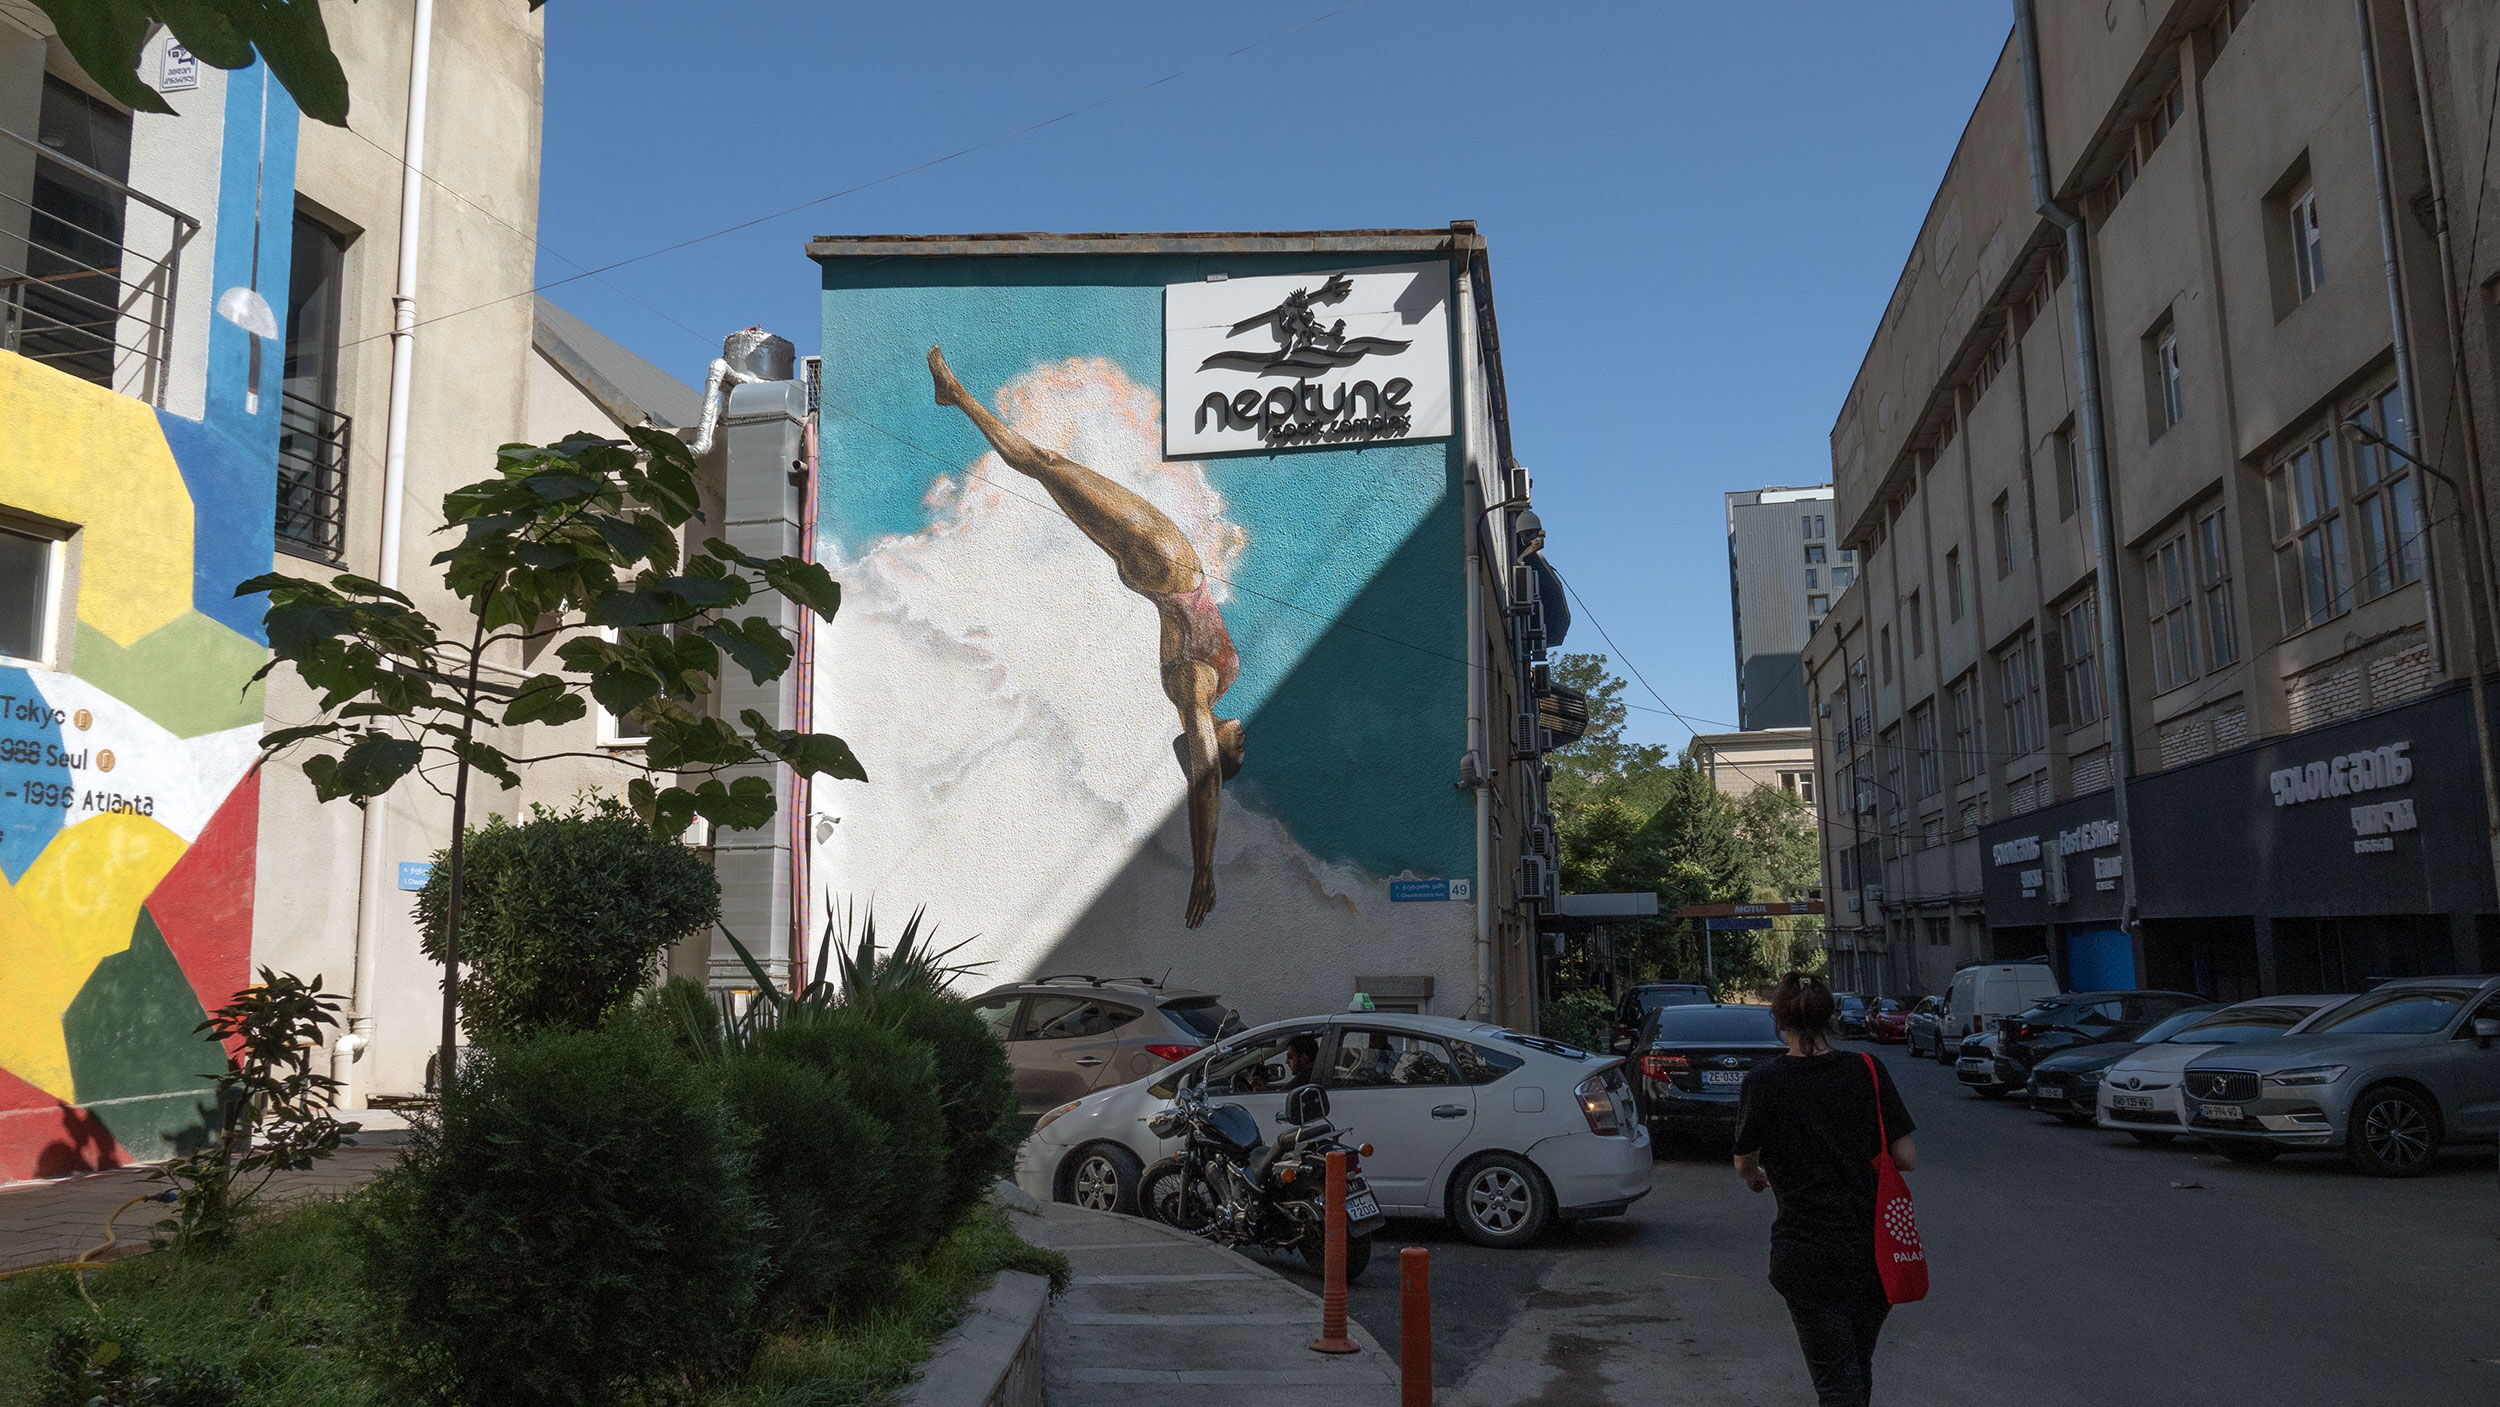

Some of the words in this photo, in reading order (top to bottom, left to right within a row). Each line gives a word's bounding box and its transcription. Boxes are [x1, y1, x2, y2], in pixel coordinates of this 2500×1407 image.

[1200, 375, 1414, 434] neptune
[1270, 416, 1325, 443] sport
[1330, 410, 1412, 438] complex
[0, 695, 66, 730] Tokyo
[0, 737, 42, 765] 988
[45, 744, 88, 770] Seul
[23, 780, 75, 809] 1996
[82, 789, 154, 817] Atlanta
[1451, 884, 1468, 896] 49
[1734, 905, 1768, 913] MOTUL
[1709, 1071, 1746, 1082] ZE-033-
[1350, 1203, 1377, 1218] 7200
